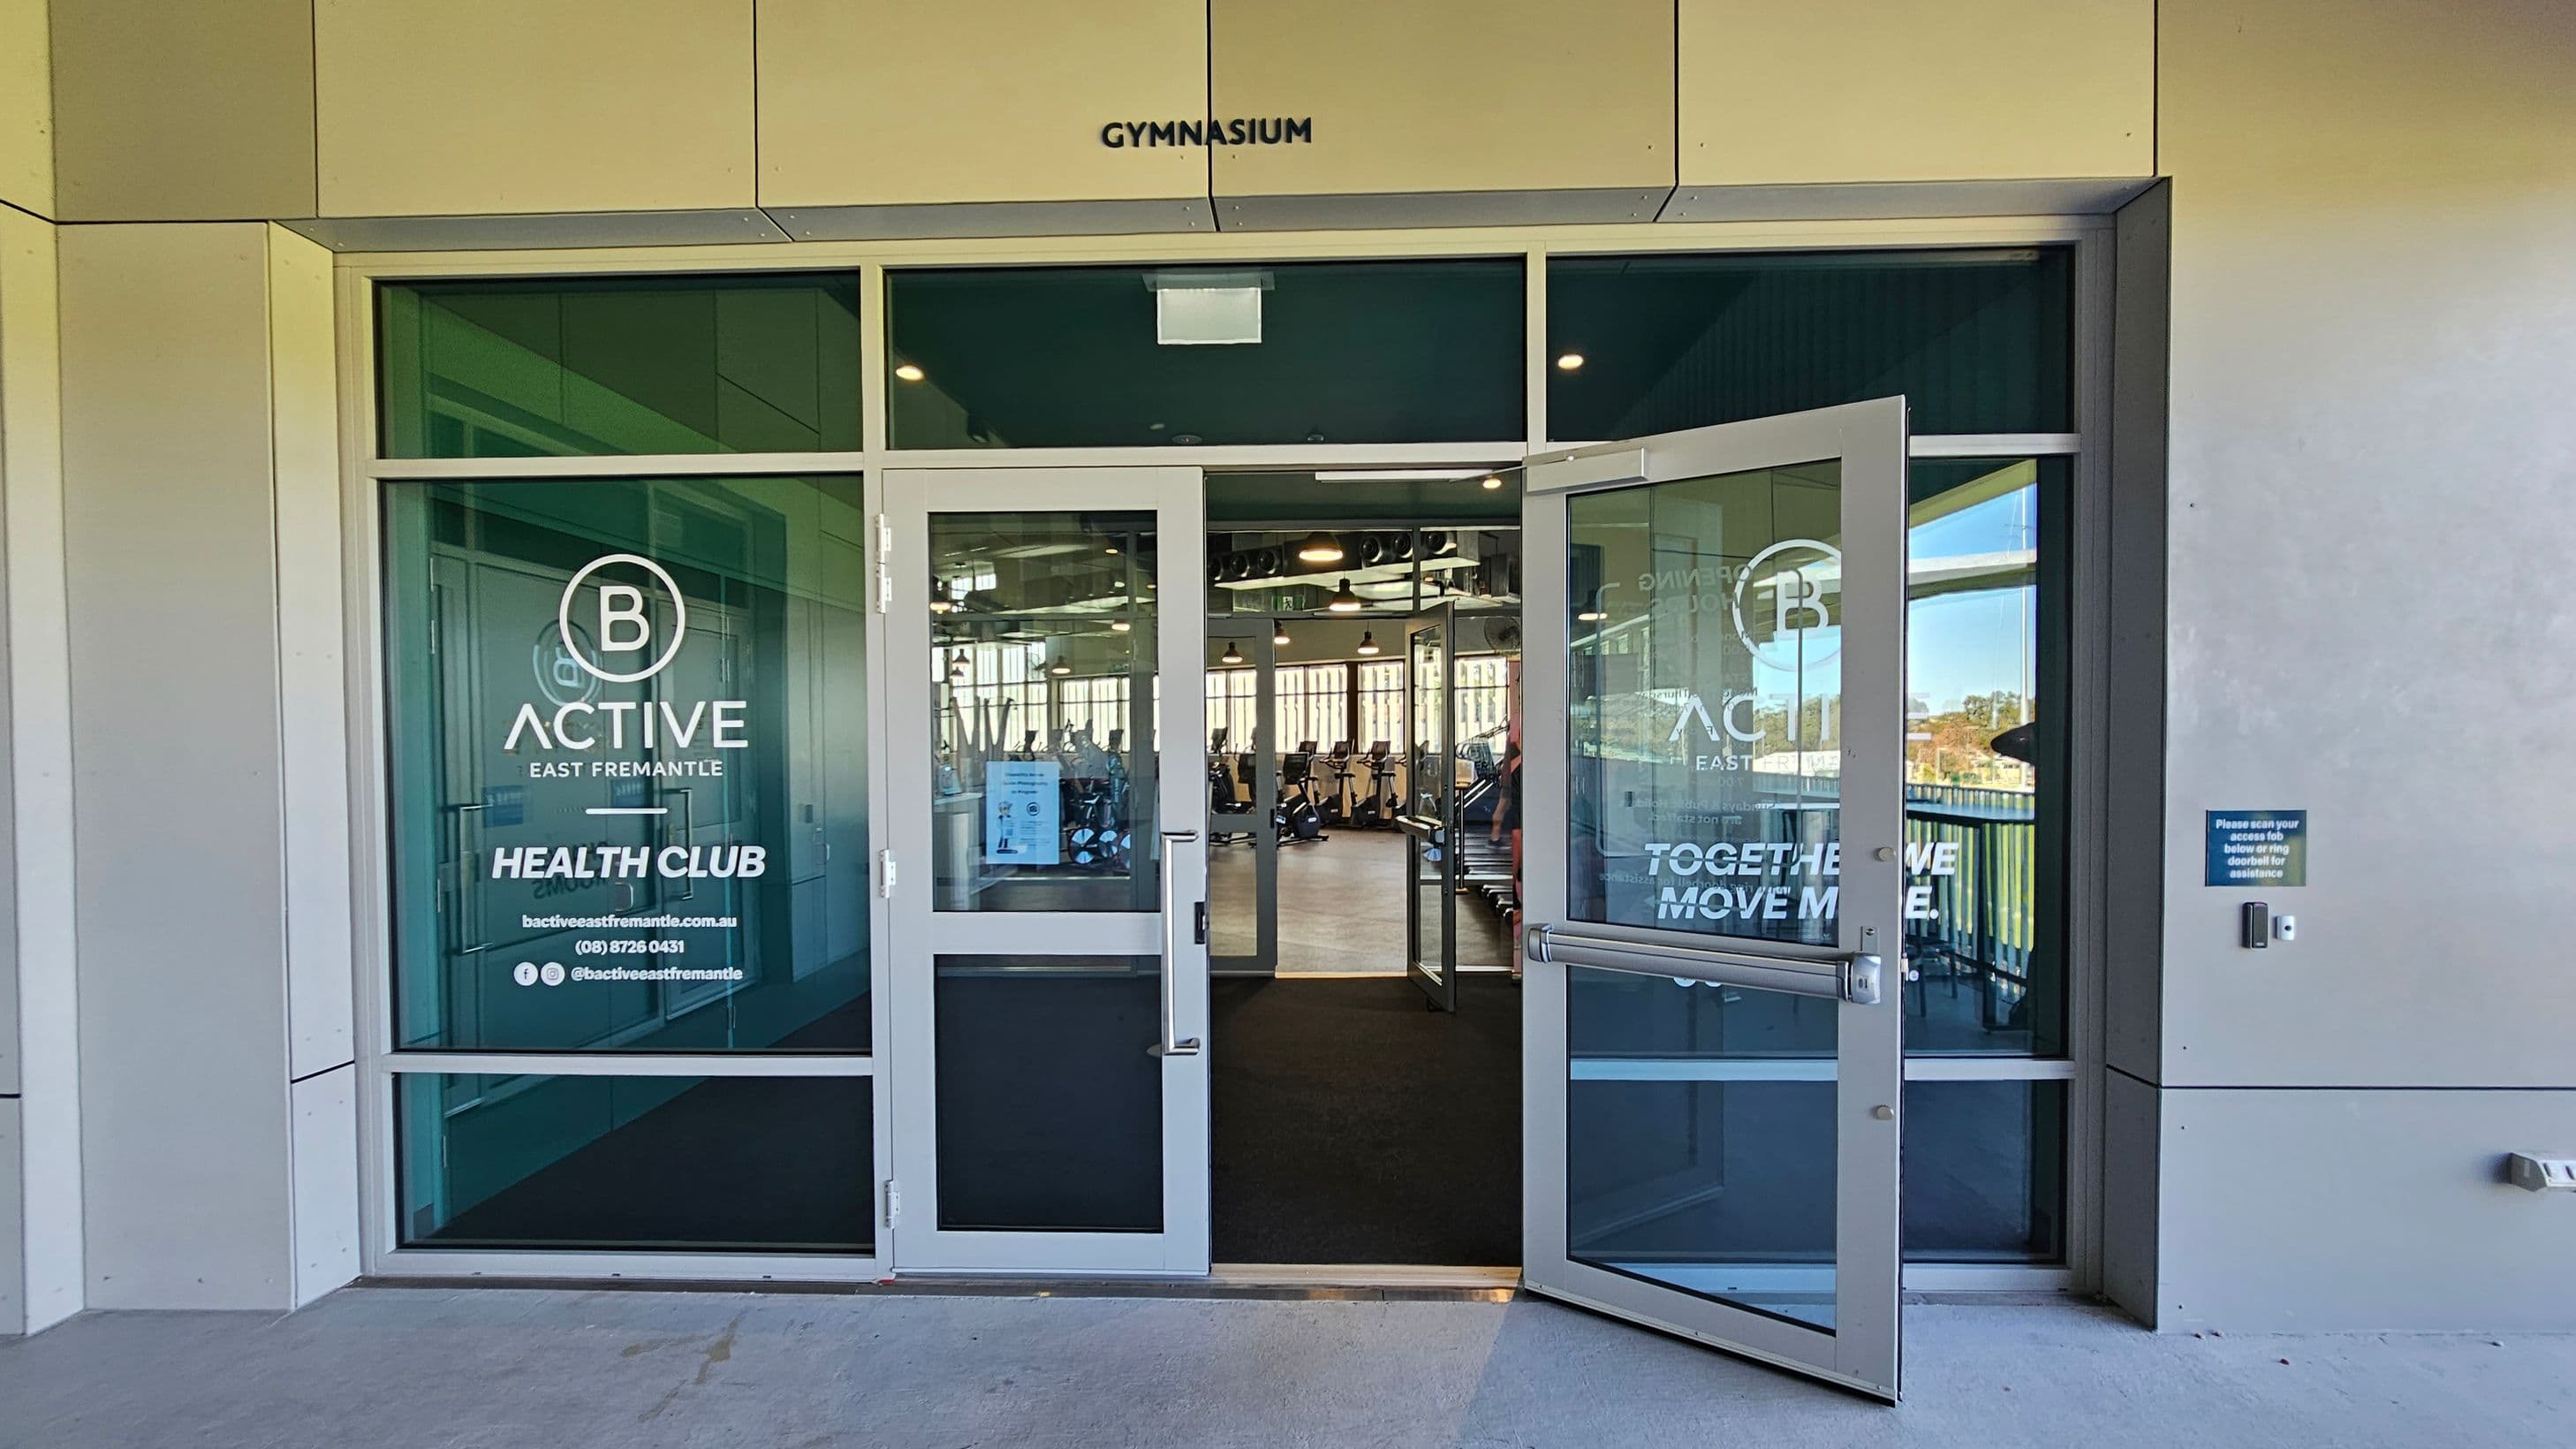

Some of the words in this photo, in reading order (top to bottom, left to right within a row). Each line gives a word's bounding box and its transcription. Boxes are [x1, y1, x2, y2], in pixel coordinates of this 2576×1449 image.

[1102, 117, 1312, 148] GYMNASIUM
[1777, 571, 1829, 634] B
[599, 585, 650, 652] B
[504, 700, 749, 750] ACTIVE
[530, 762, 583, 778] EAST
[592, 760, 724, 778] FREMANTLE
[2216, 818, 2248, 830] Please
[2276, 820, 2299, 831] your
[2267, 831, 2284, 841] fob
[2224, 844, 2254, 853] below
[2255, 845, 2268, 853] or
[2269, 844, 2289, 855] ring
[491, 846, 650, 879] HEALTH
[656, 846, 766, 879] CLUB
[1644, 841, 1840, 876] TOGETHE
[2228, 855, 2269, 866] doorbell
[2270, 855, 2285, 866] for
[2230, 868, 2283, 878] assistance
[1657, 887, 1791, 921] MOVE
[522, 914, 737, 930] bactiveeastfremantle.com.au
[575, 939, 608, 956] (08)
[610, 941, 647, 954] 8726
[648, 941, 685, 954] 0431
[571, 966, 743, 982] @bactiveeastfremantle
